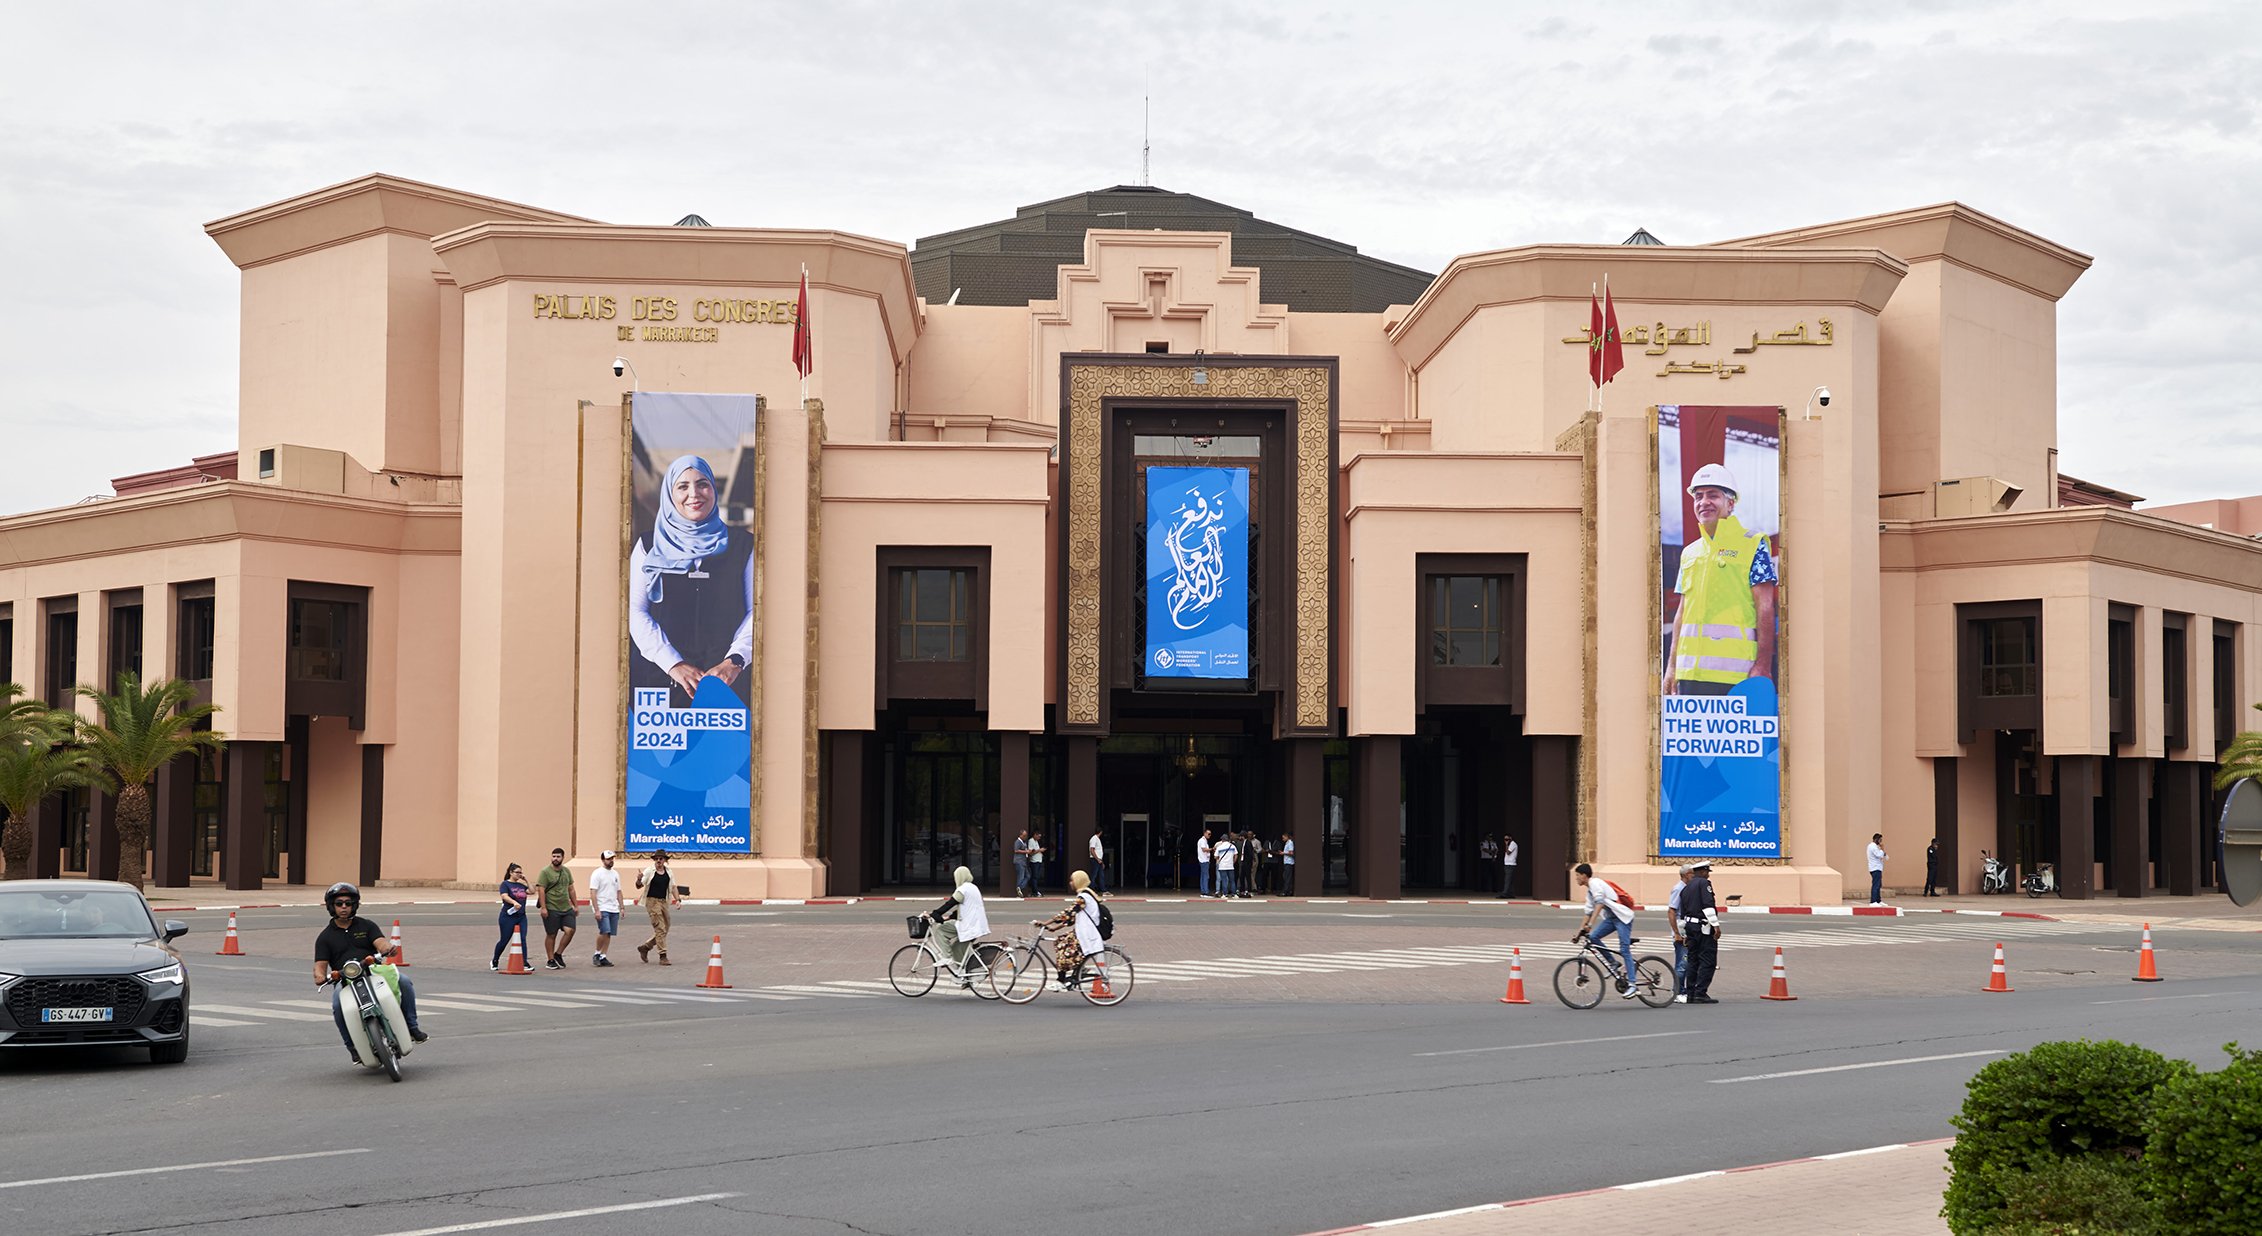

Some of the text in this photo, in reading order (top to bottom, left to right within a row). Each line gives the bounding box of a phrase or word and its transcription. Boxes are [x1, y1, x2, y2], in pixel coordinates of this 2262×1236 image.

[534, 294, 616, 320] PALAIS
[631, 296, 678, 321] DES
[617, 325, 718, 343] DE MARRAKECH
[1561, 316, 1833, 356] قصر المؤتمت
[1656, 359, 1746, 379] مراكش
[638, 691, 666, 706] ITF
[1666, 699, 1744, 714] MOVING
[637, 711, 743, 728] CONGRESS
[1665, 719, 1776, 734] THE WORLD
[637, 732, 684, 747] 2024
[1666, 738, 1760, 754] FORWARD
[651, 815, 735, 829] مراكش المغرب
[1684, 820, 1765, 835] مراكش المغرب
[630, 833, 746, 845] Marrakech Morocco
[1664, 838, 1777, 850] Marrakech Morocco
[51, 1009, 105, 1020] GS-447-GV
